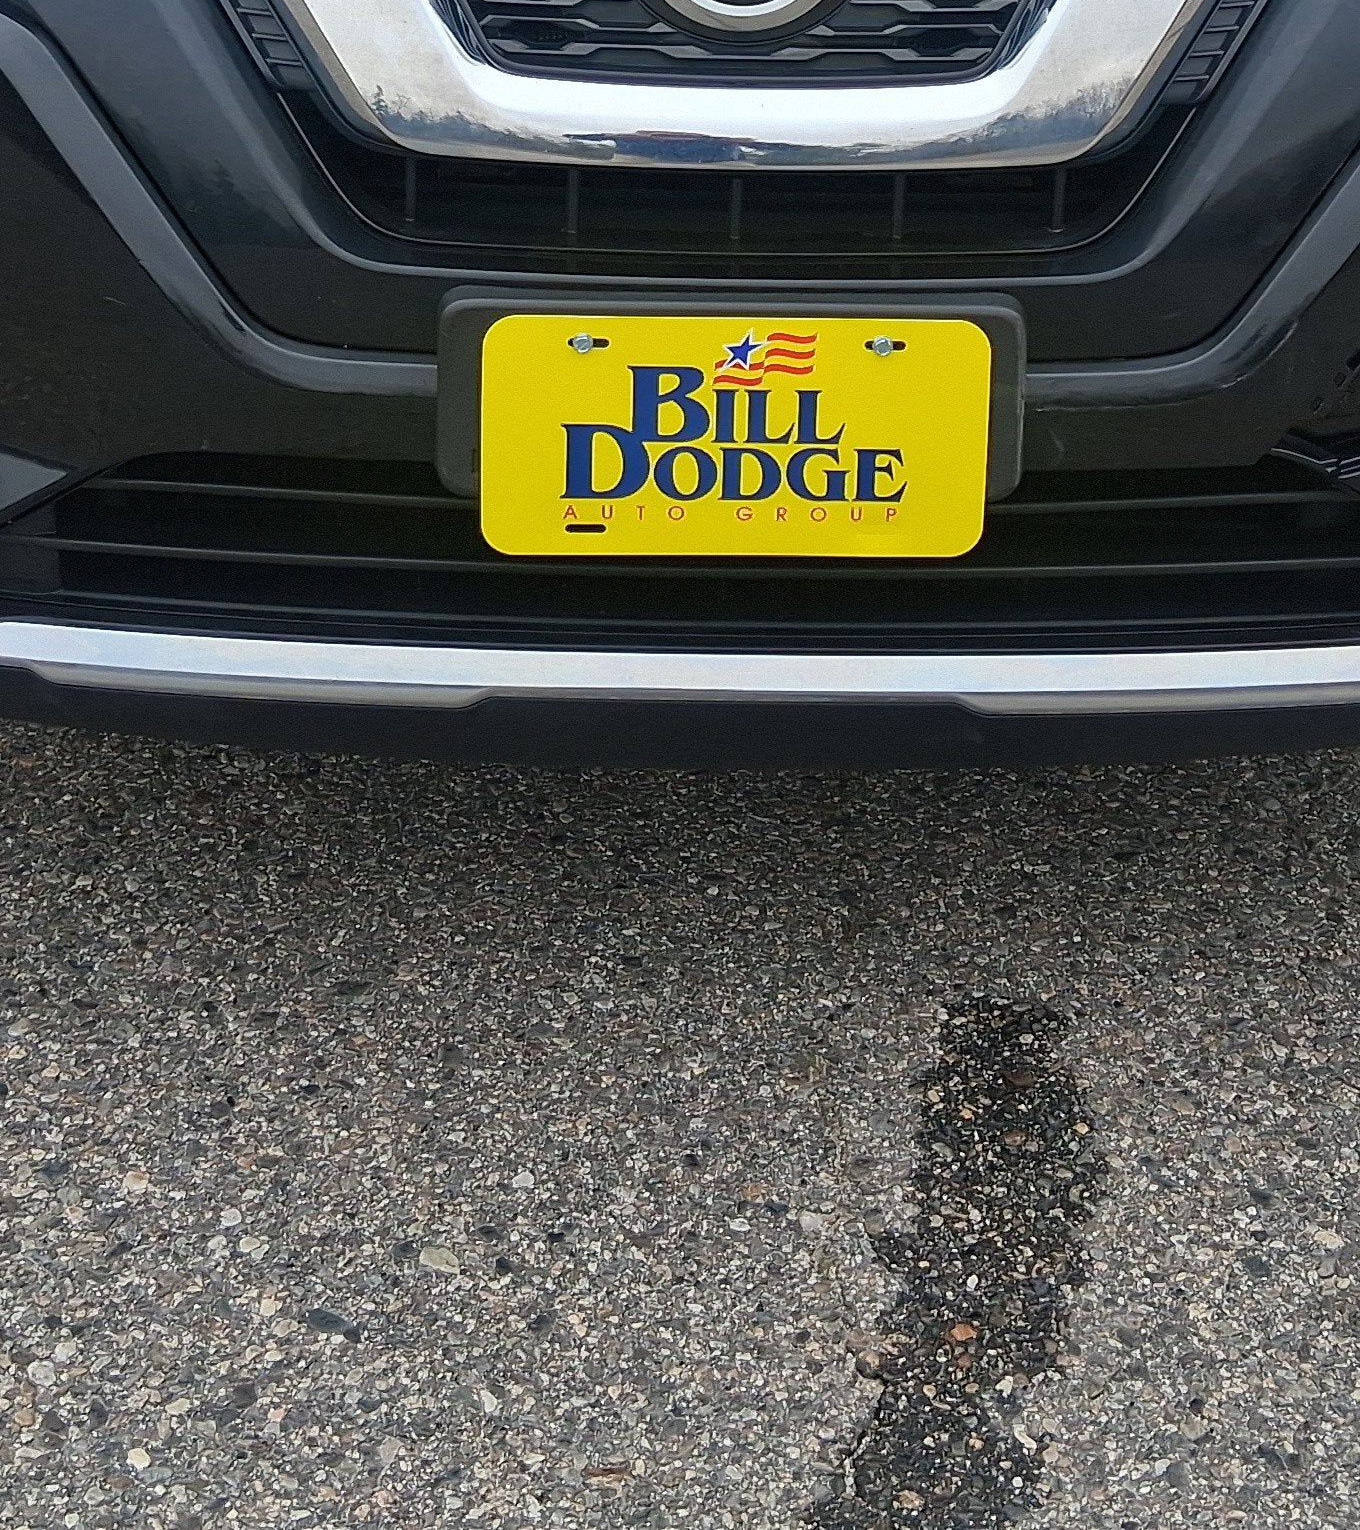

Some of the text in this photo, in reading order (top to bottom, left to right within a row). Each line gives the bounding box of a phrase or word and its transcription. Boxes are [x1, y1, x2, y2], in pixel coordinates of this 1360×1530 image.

[627, 365, 846, 445] BILL
[560, 422, 908, 503] DODGE
[563, 505, 898, 522] AUTO GROUP
